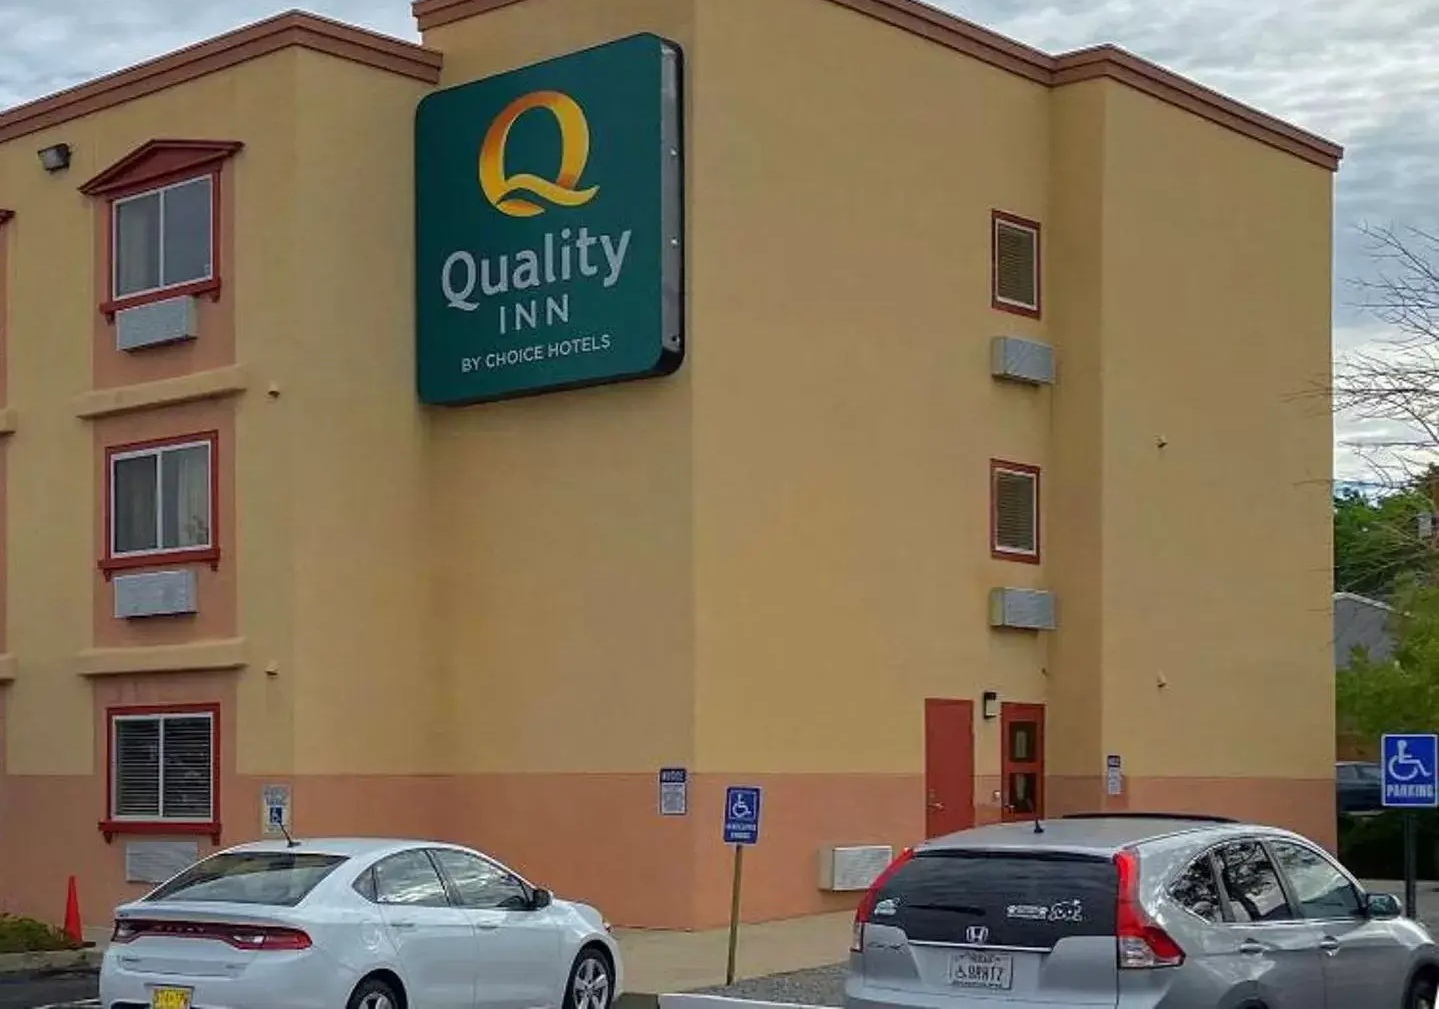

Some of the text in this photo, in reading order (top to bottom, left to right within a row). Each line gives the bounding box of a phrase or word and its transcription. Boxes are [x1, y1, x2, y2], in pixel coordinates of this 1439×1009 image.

[479, 90, 600, 217] Q
[441, 227, 632, 311] Quality
[499, 294, 570, 334] INN
[462, 334, 610, 373] BY CHOICE HOTELS
[1386, 784, 1434, 798] PARKING
